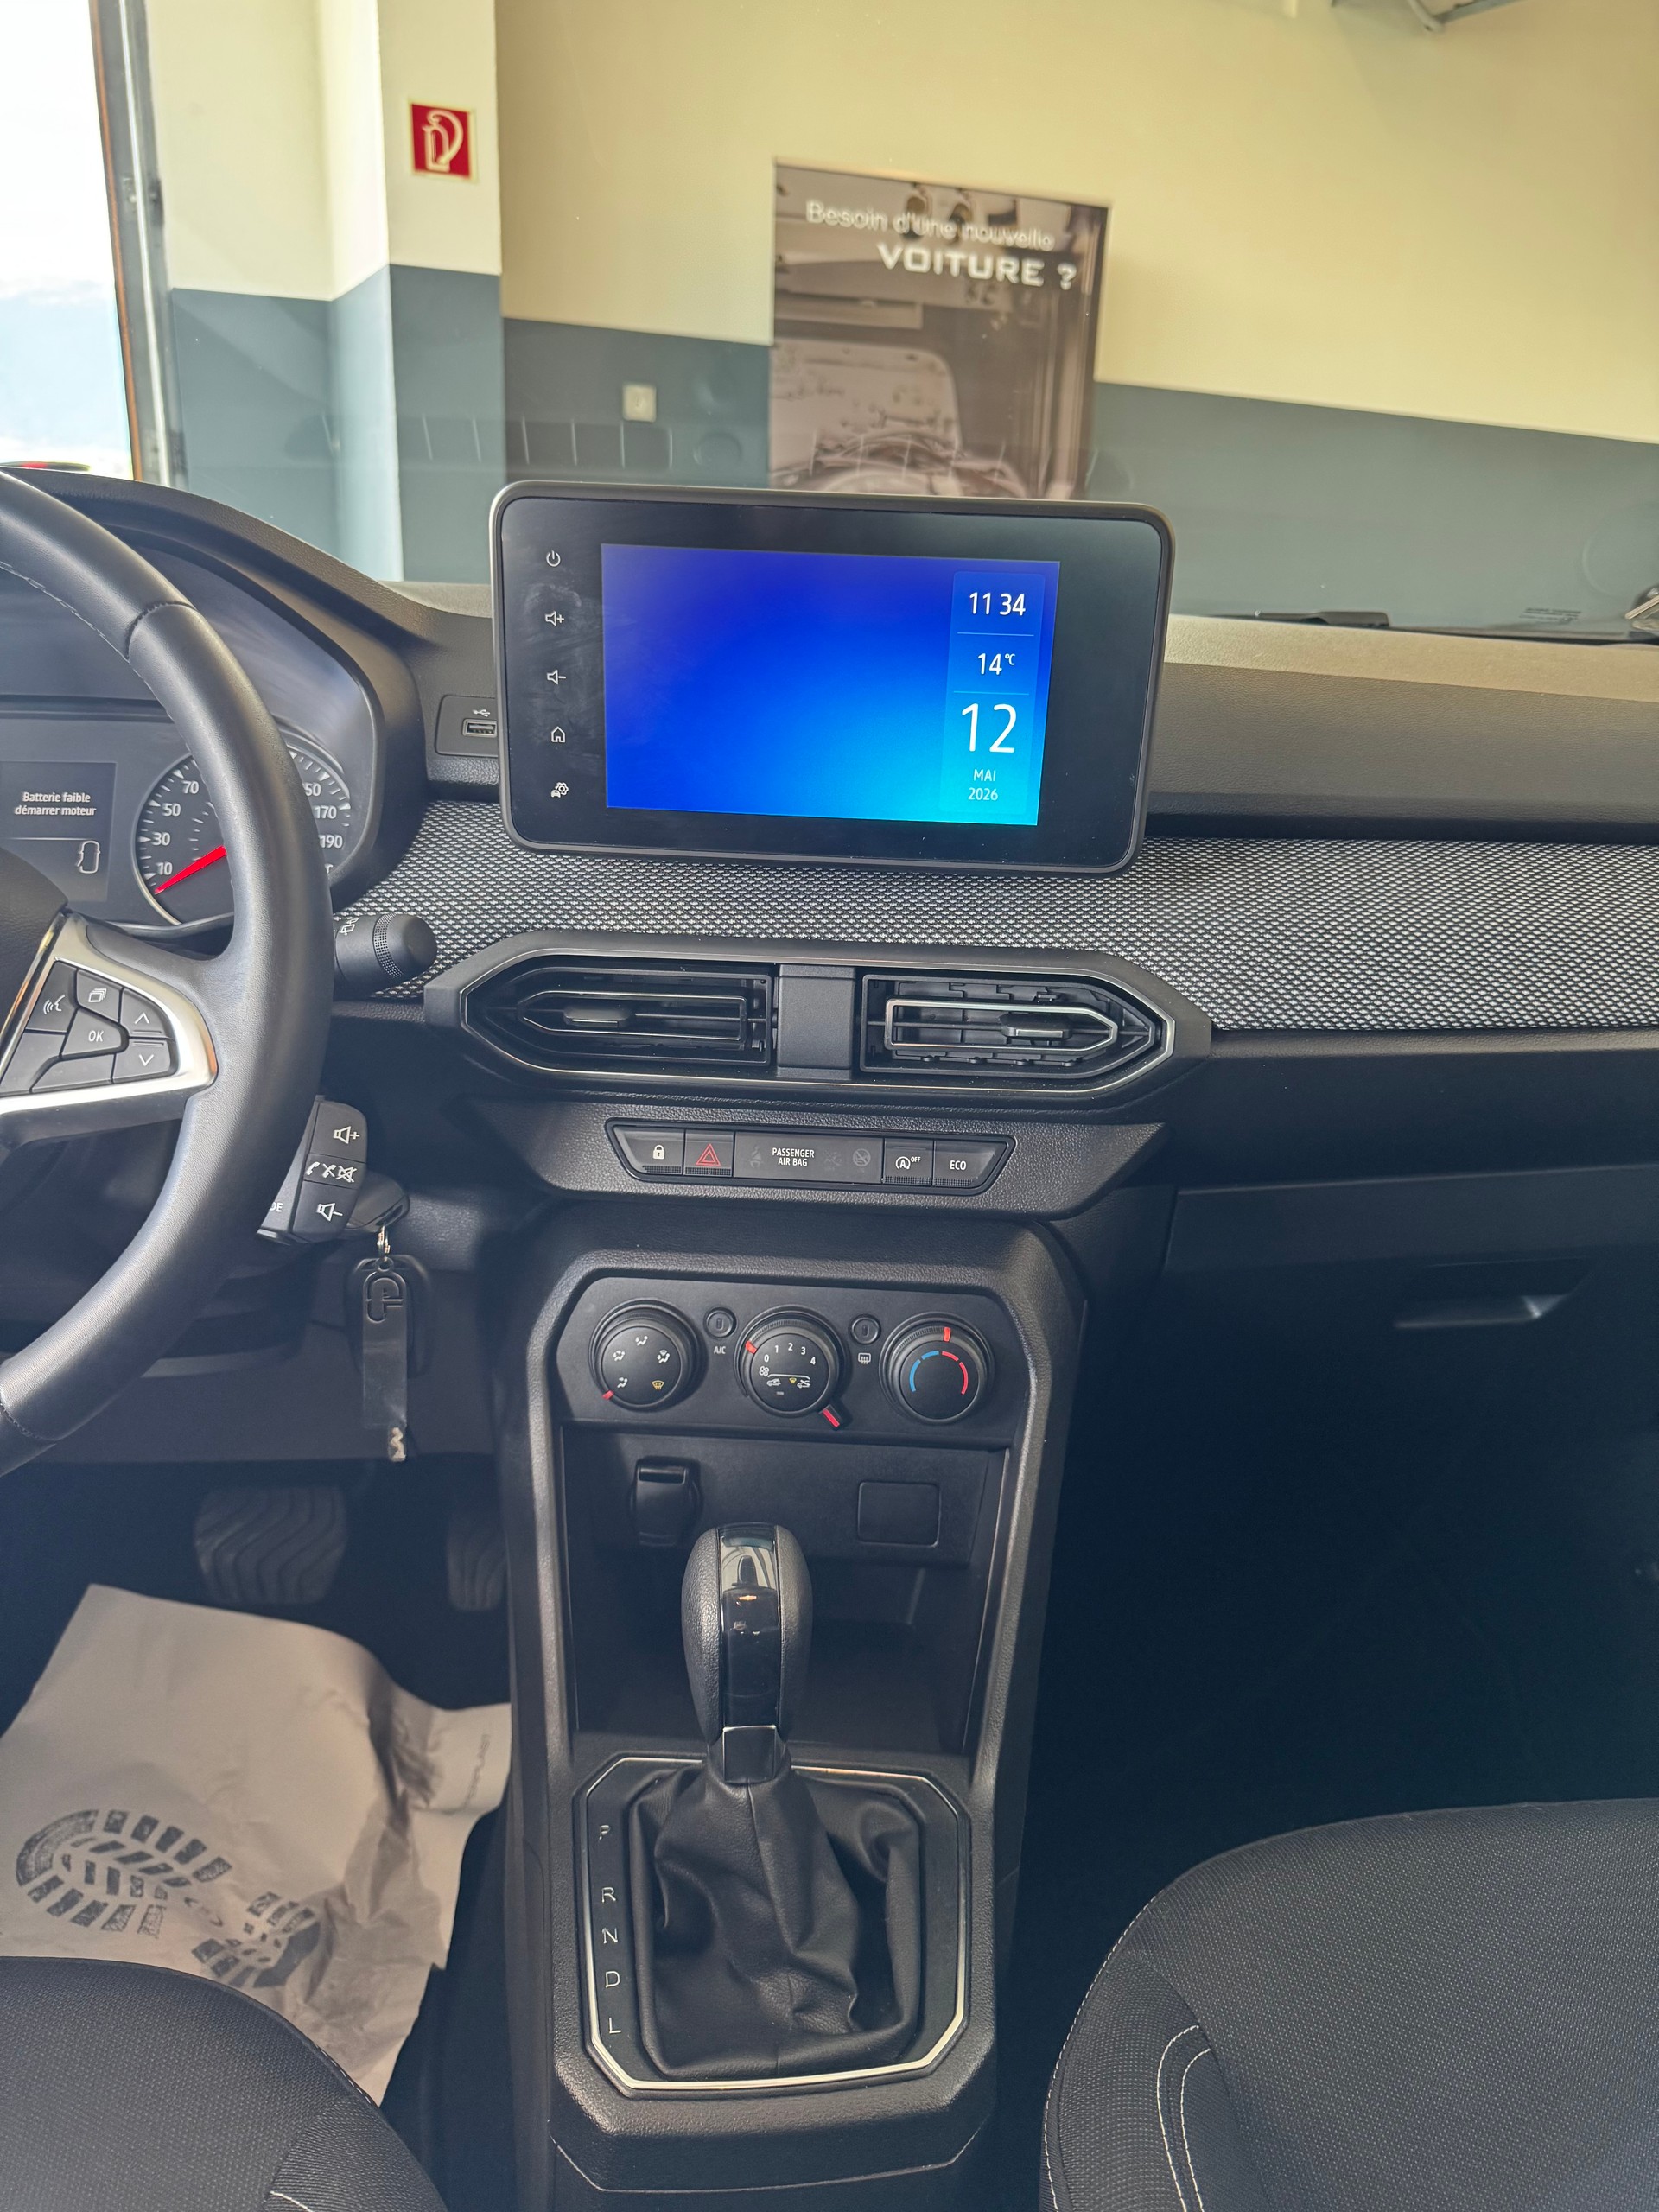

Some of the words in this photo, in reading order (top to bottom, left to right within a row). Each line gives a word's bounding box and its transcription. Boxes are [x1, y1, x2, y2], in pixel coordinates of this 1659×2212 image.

[806, 200, 888, 231] Besoin
[893, 212, 957, 239] d'une
[961, 222, 1055, 251] nouvelle
[877, 242, 1045, 288] VOITURE
[1057, 263, 1077, 290] ?
[961, 702, 1017, 753] 12
[973, 768, 996, 782] MAI
[181, 780, 200, 794] 70
[302, 782, 321, 797] 50
[968, 787, 999, 801] 2026
[22, 791, 61, 803] Batterie
[63, 792, 91, 803] faible
[15, 804, 60, 815] démarrer
[61, 806, 97, 816] moteur
[162, 803, 181, 817] 50
[314, 804, 337, 819] 170
[151, 831, 171, 846] 30
[318, 834, 343, 849] 190
[156, 861, 173, 875] 10
[88, 1030, 105, 1042] OK
[772, 1147, 815, 1159] PASSENGER
[778, 1157, 791, 1166] AIR
[792, 1158, 808, 1167] BAG
[950, 1160, 967, 1171] ECO
[713, 1345, 727, 1355] A/C
[764, 1354, 770, 1363] 0
[774, 1344, 779, 1354] 1
[787, 1342, 794, 1351] 2
[800, 1346, 806, 1356] 3
[810, 1357, 817, 1366] 4
[601, 1886, 616, 1903] R
[601, 1928, 618, 1944] N
[605, 1970, 621, 1988] D
[608, 2017, 622, 2034] L
